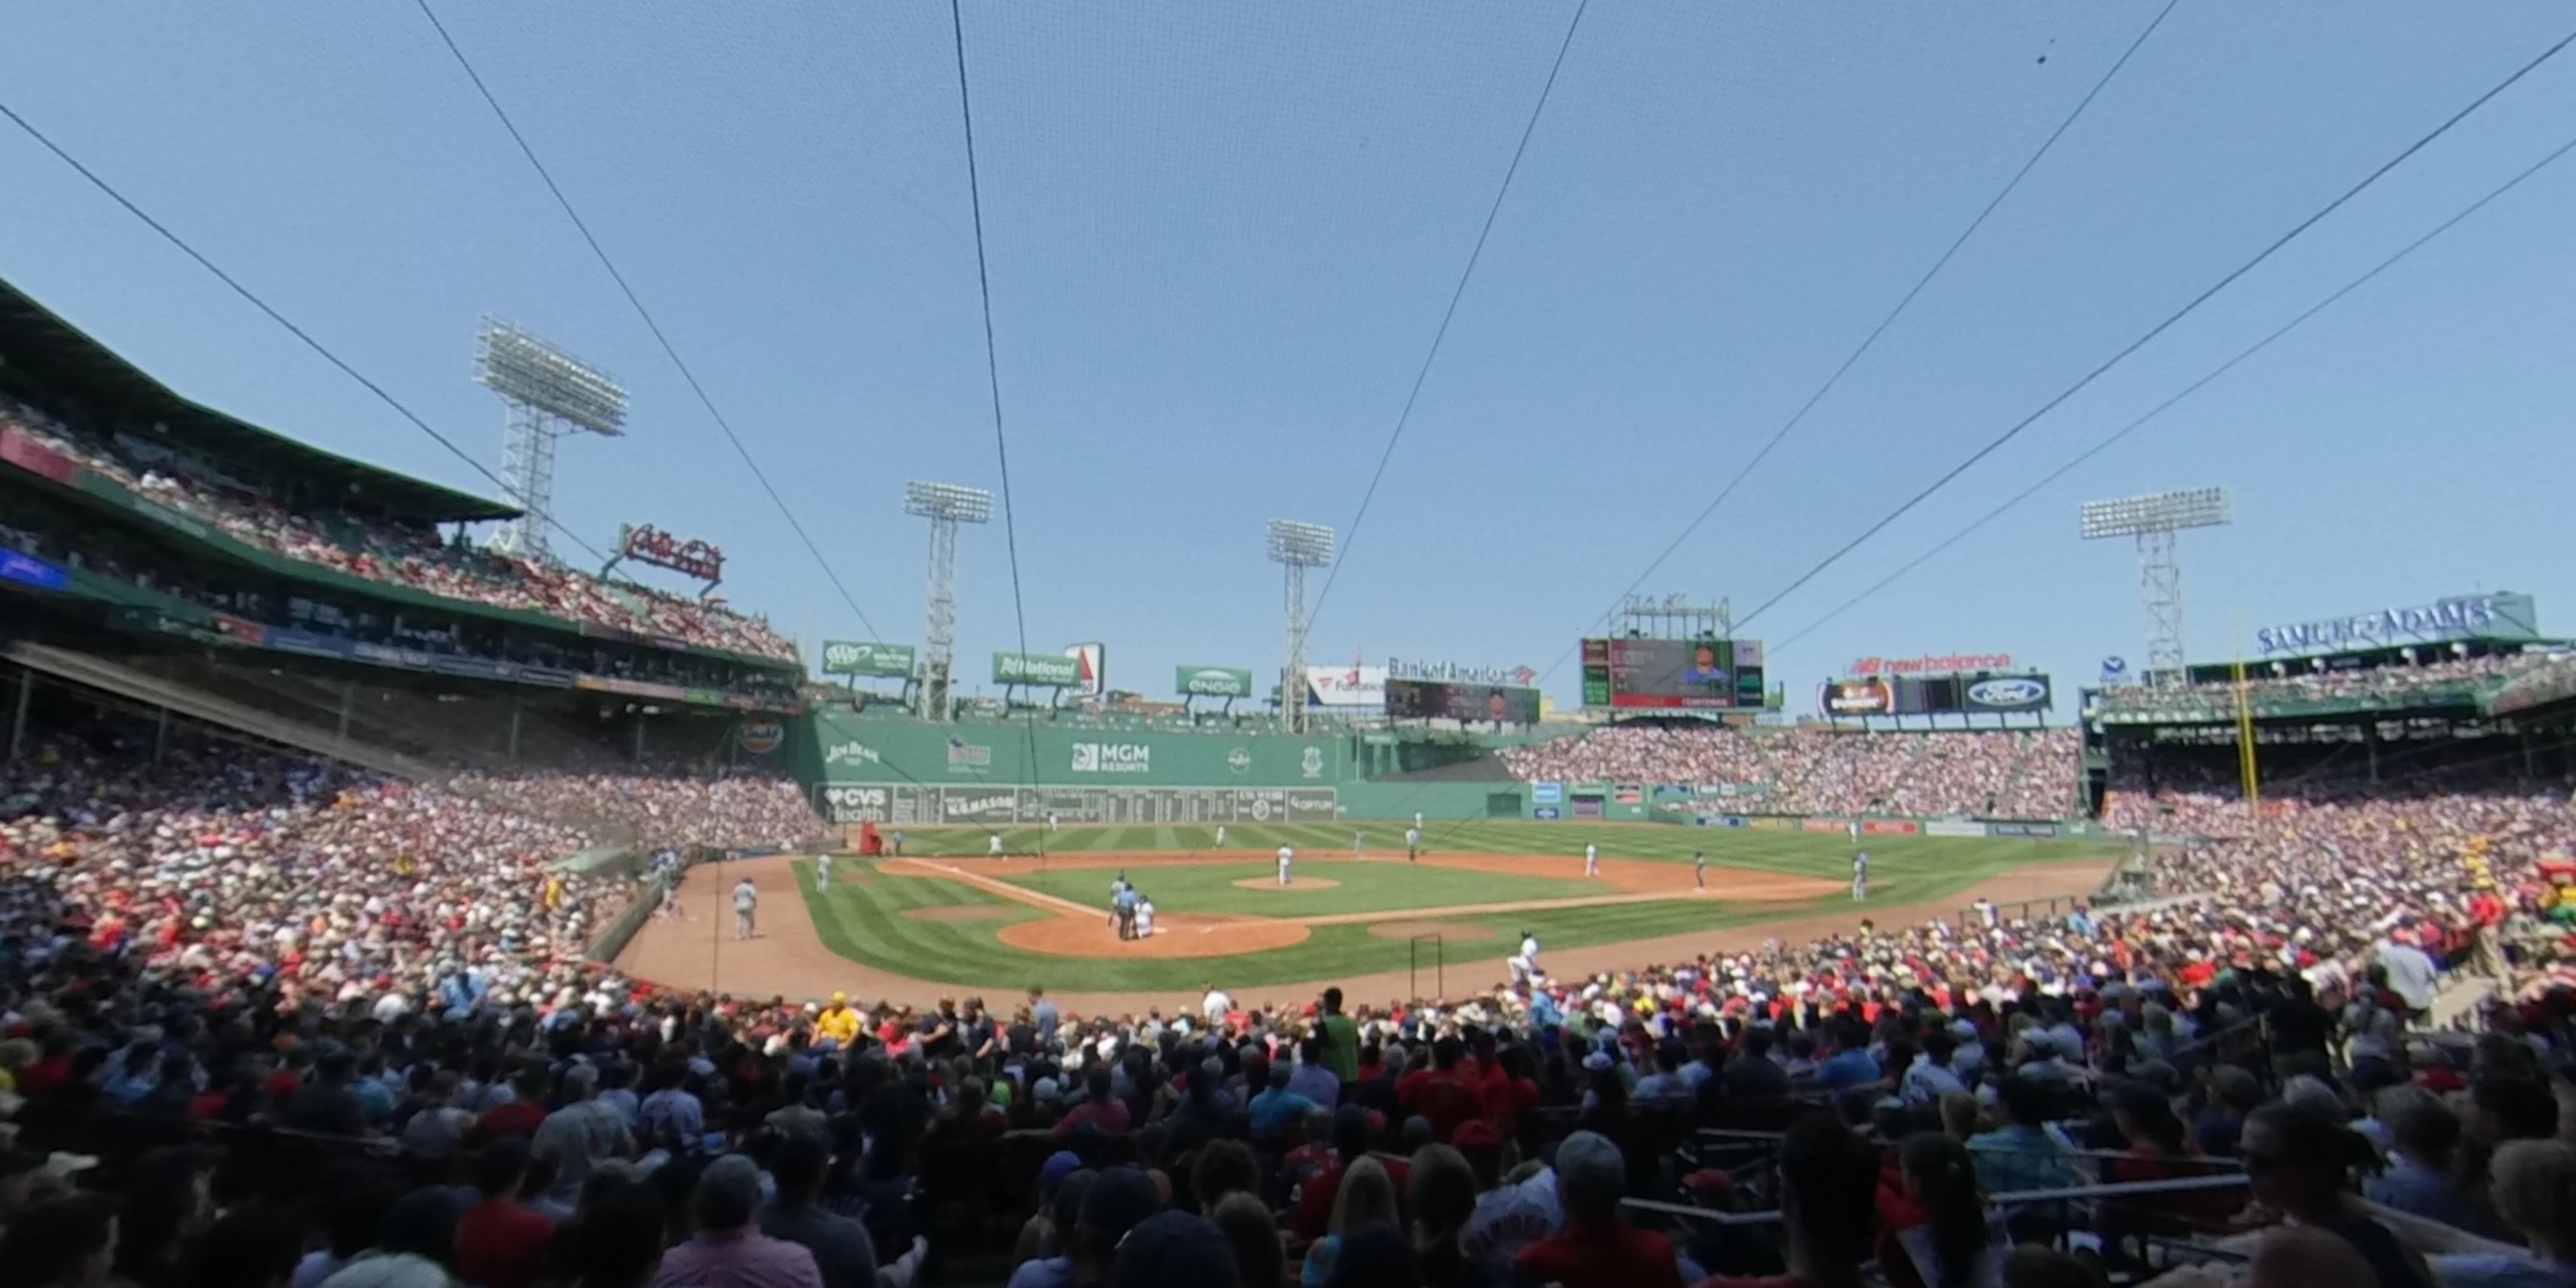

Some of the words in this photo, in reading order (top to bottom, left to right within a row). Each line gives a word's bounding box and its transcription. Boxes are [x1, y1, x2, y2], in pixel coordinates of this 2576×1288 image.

[2257, 615, 2376, 653] SAMUEL
[2379, 598, 2496, 641] ADAMS
[1018, 658, 1074, 677] National
[1389, 658, 1424, 679] Bank
[1447, 662, 1507, 682] America
[1983, 682, 2030, 702] Ford
[1101, 743, 1149, 762] MGM
[1101, 763, 1149, 773] RESORTS
[844, 788, 886, 805] CVS
[1298, 799, 1334, 811] OPTUM
[827, 806, 884, 822] Health
